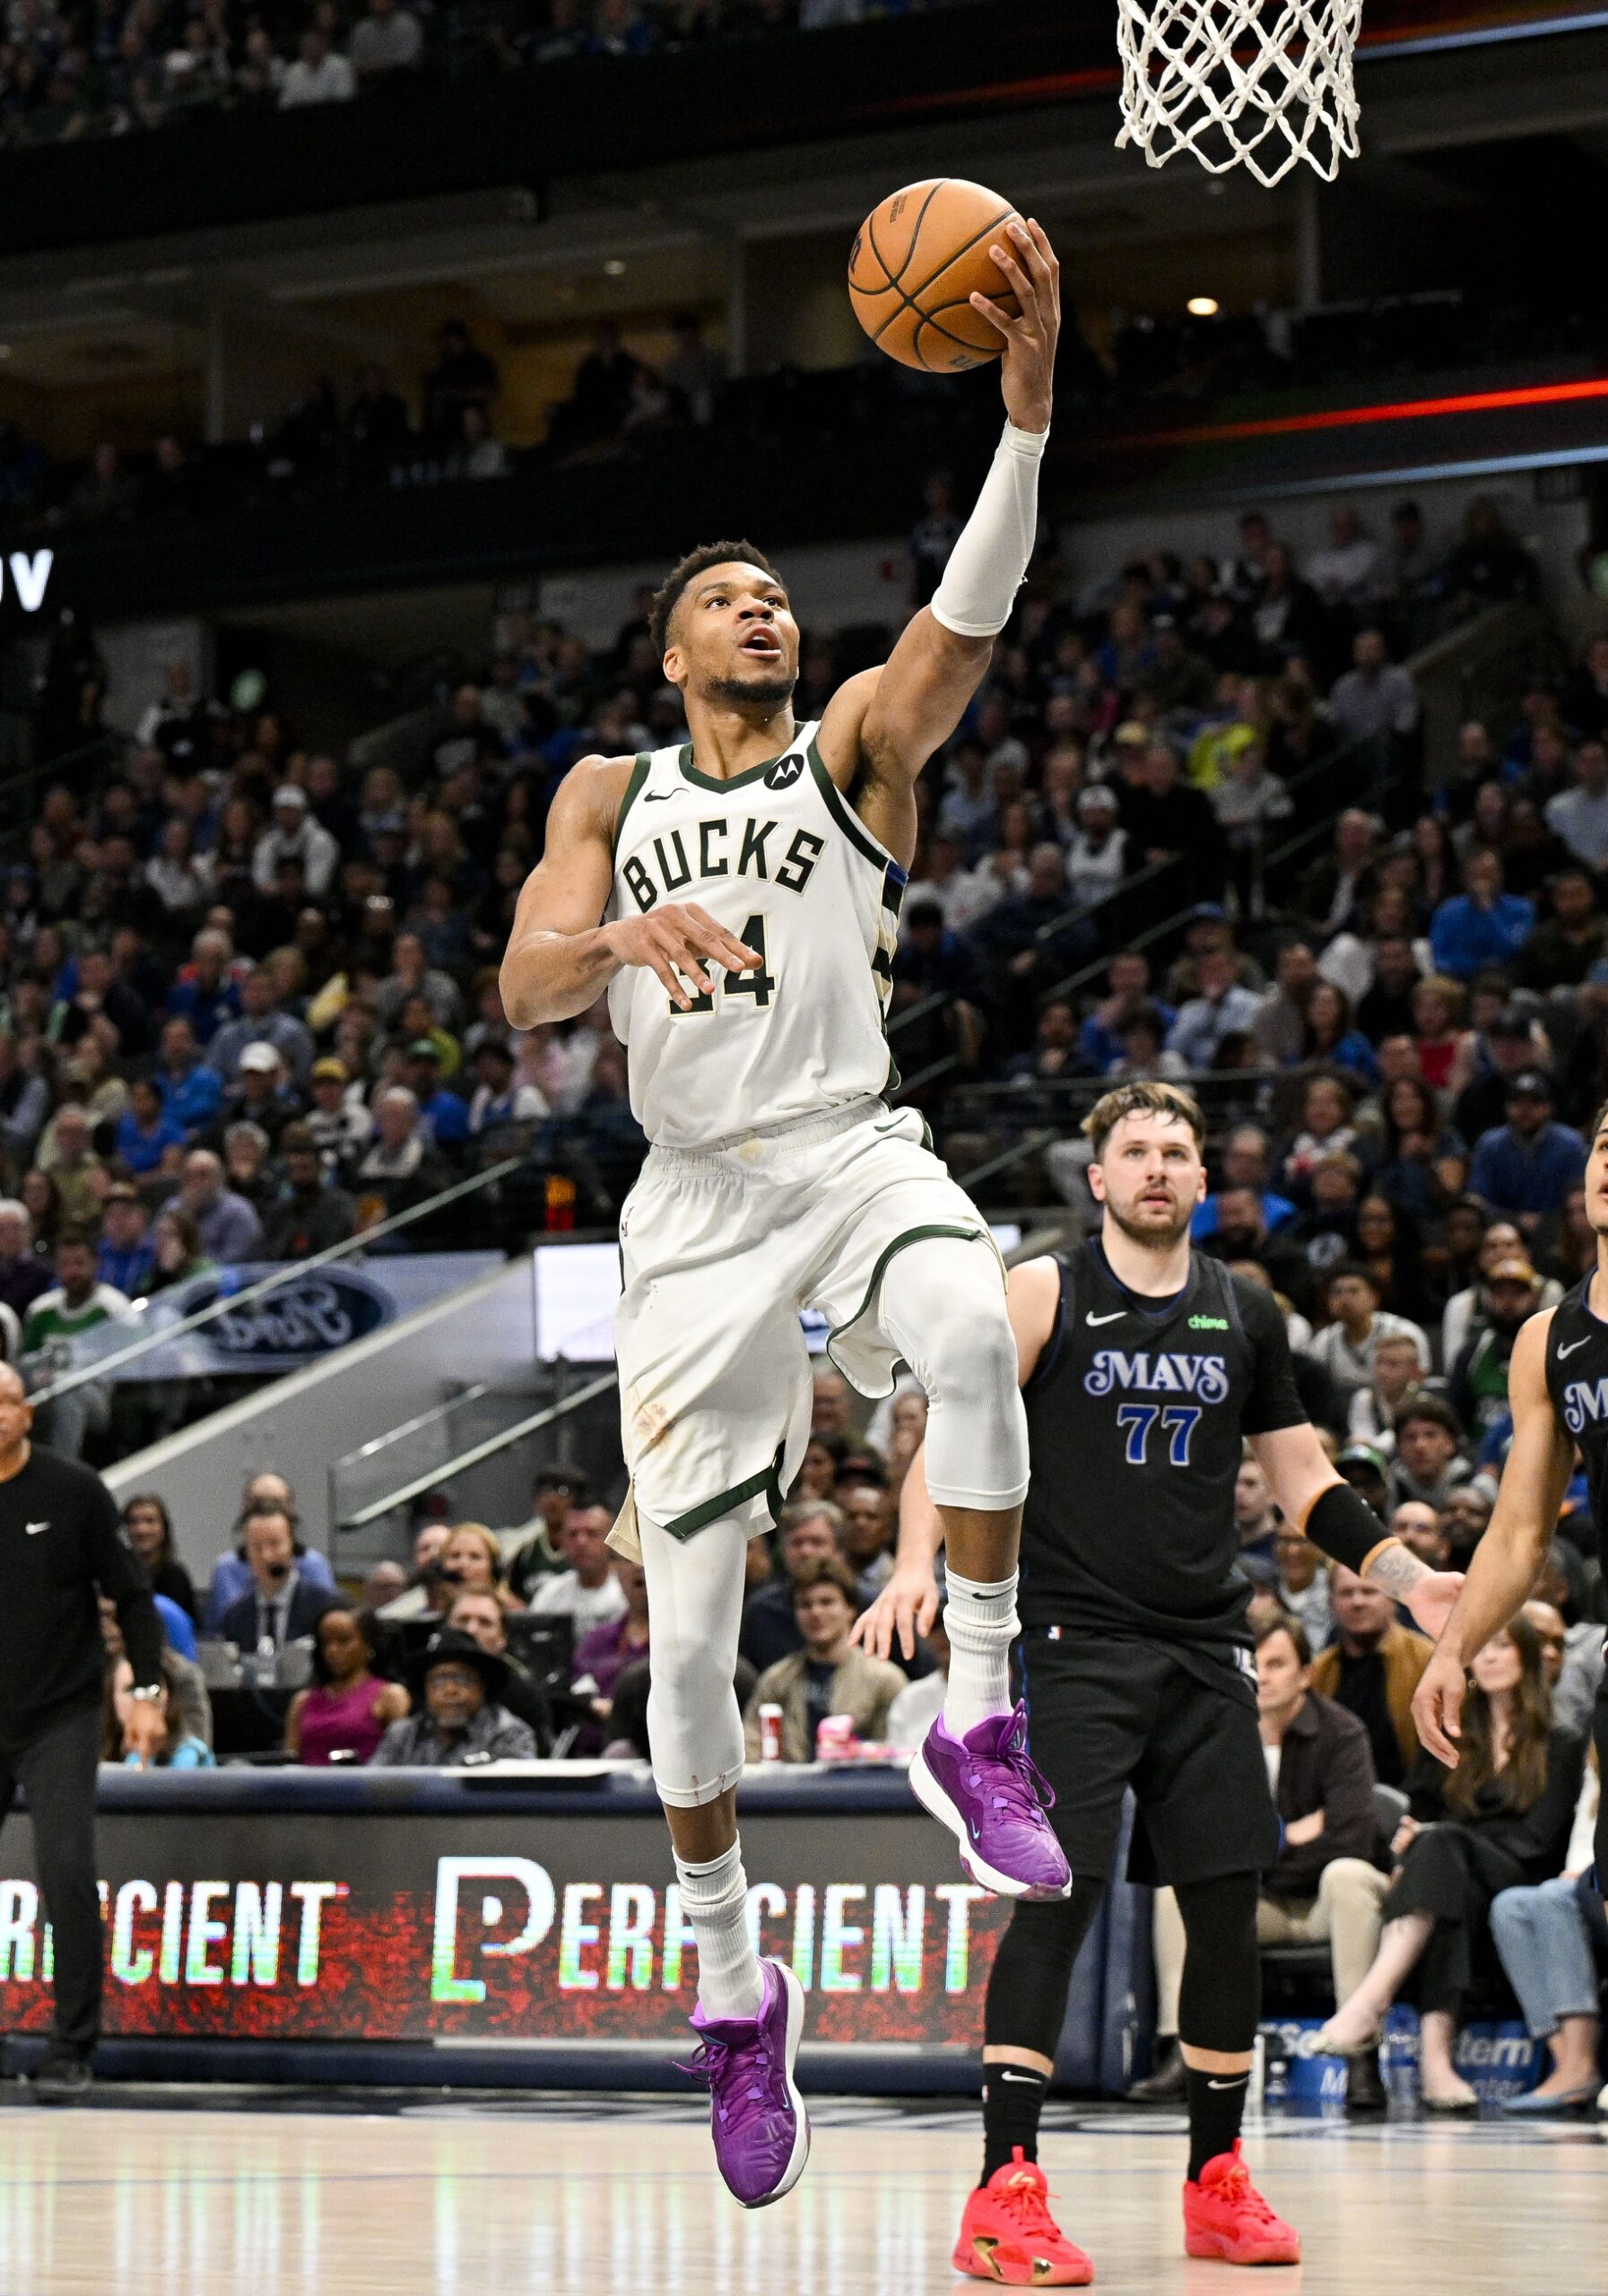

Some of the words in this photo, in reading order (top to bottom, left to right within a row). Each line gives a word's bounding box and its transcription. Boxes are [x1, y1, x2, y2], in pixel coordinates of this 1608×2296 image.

[621, 817, 828, 914] BUCKS
[1187, 1315, 1229, 1331] chime
[1083, 1350, 1230, 1405] MAVS
[1117, 1403, 1203, 1466] 77
